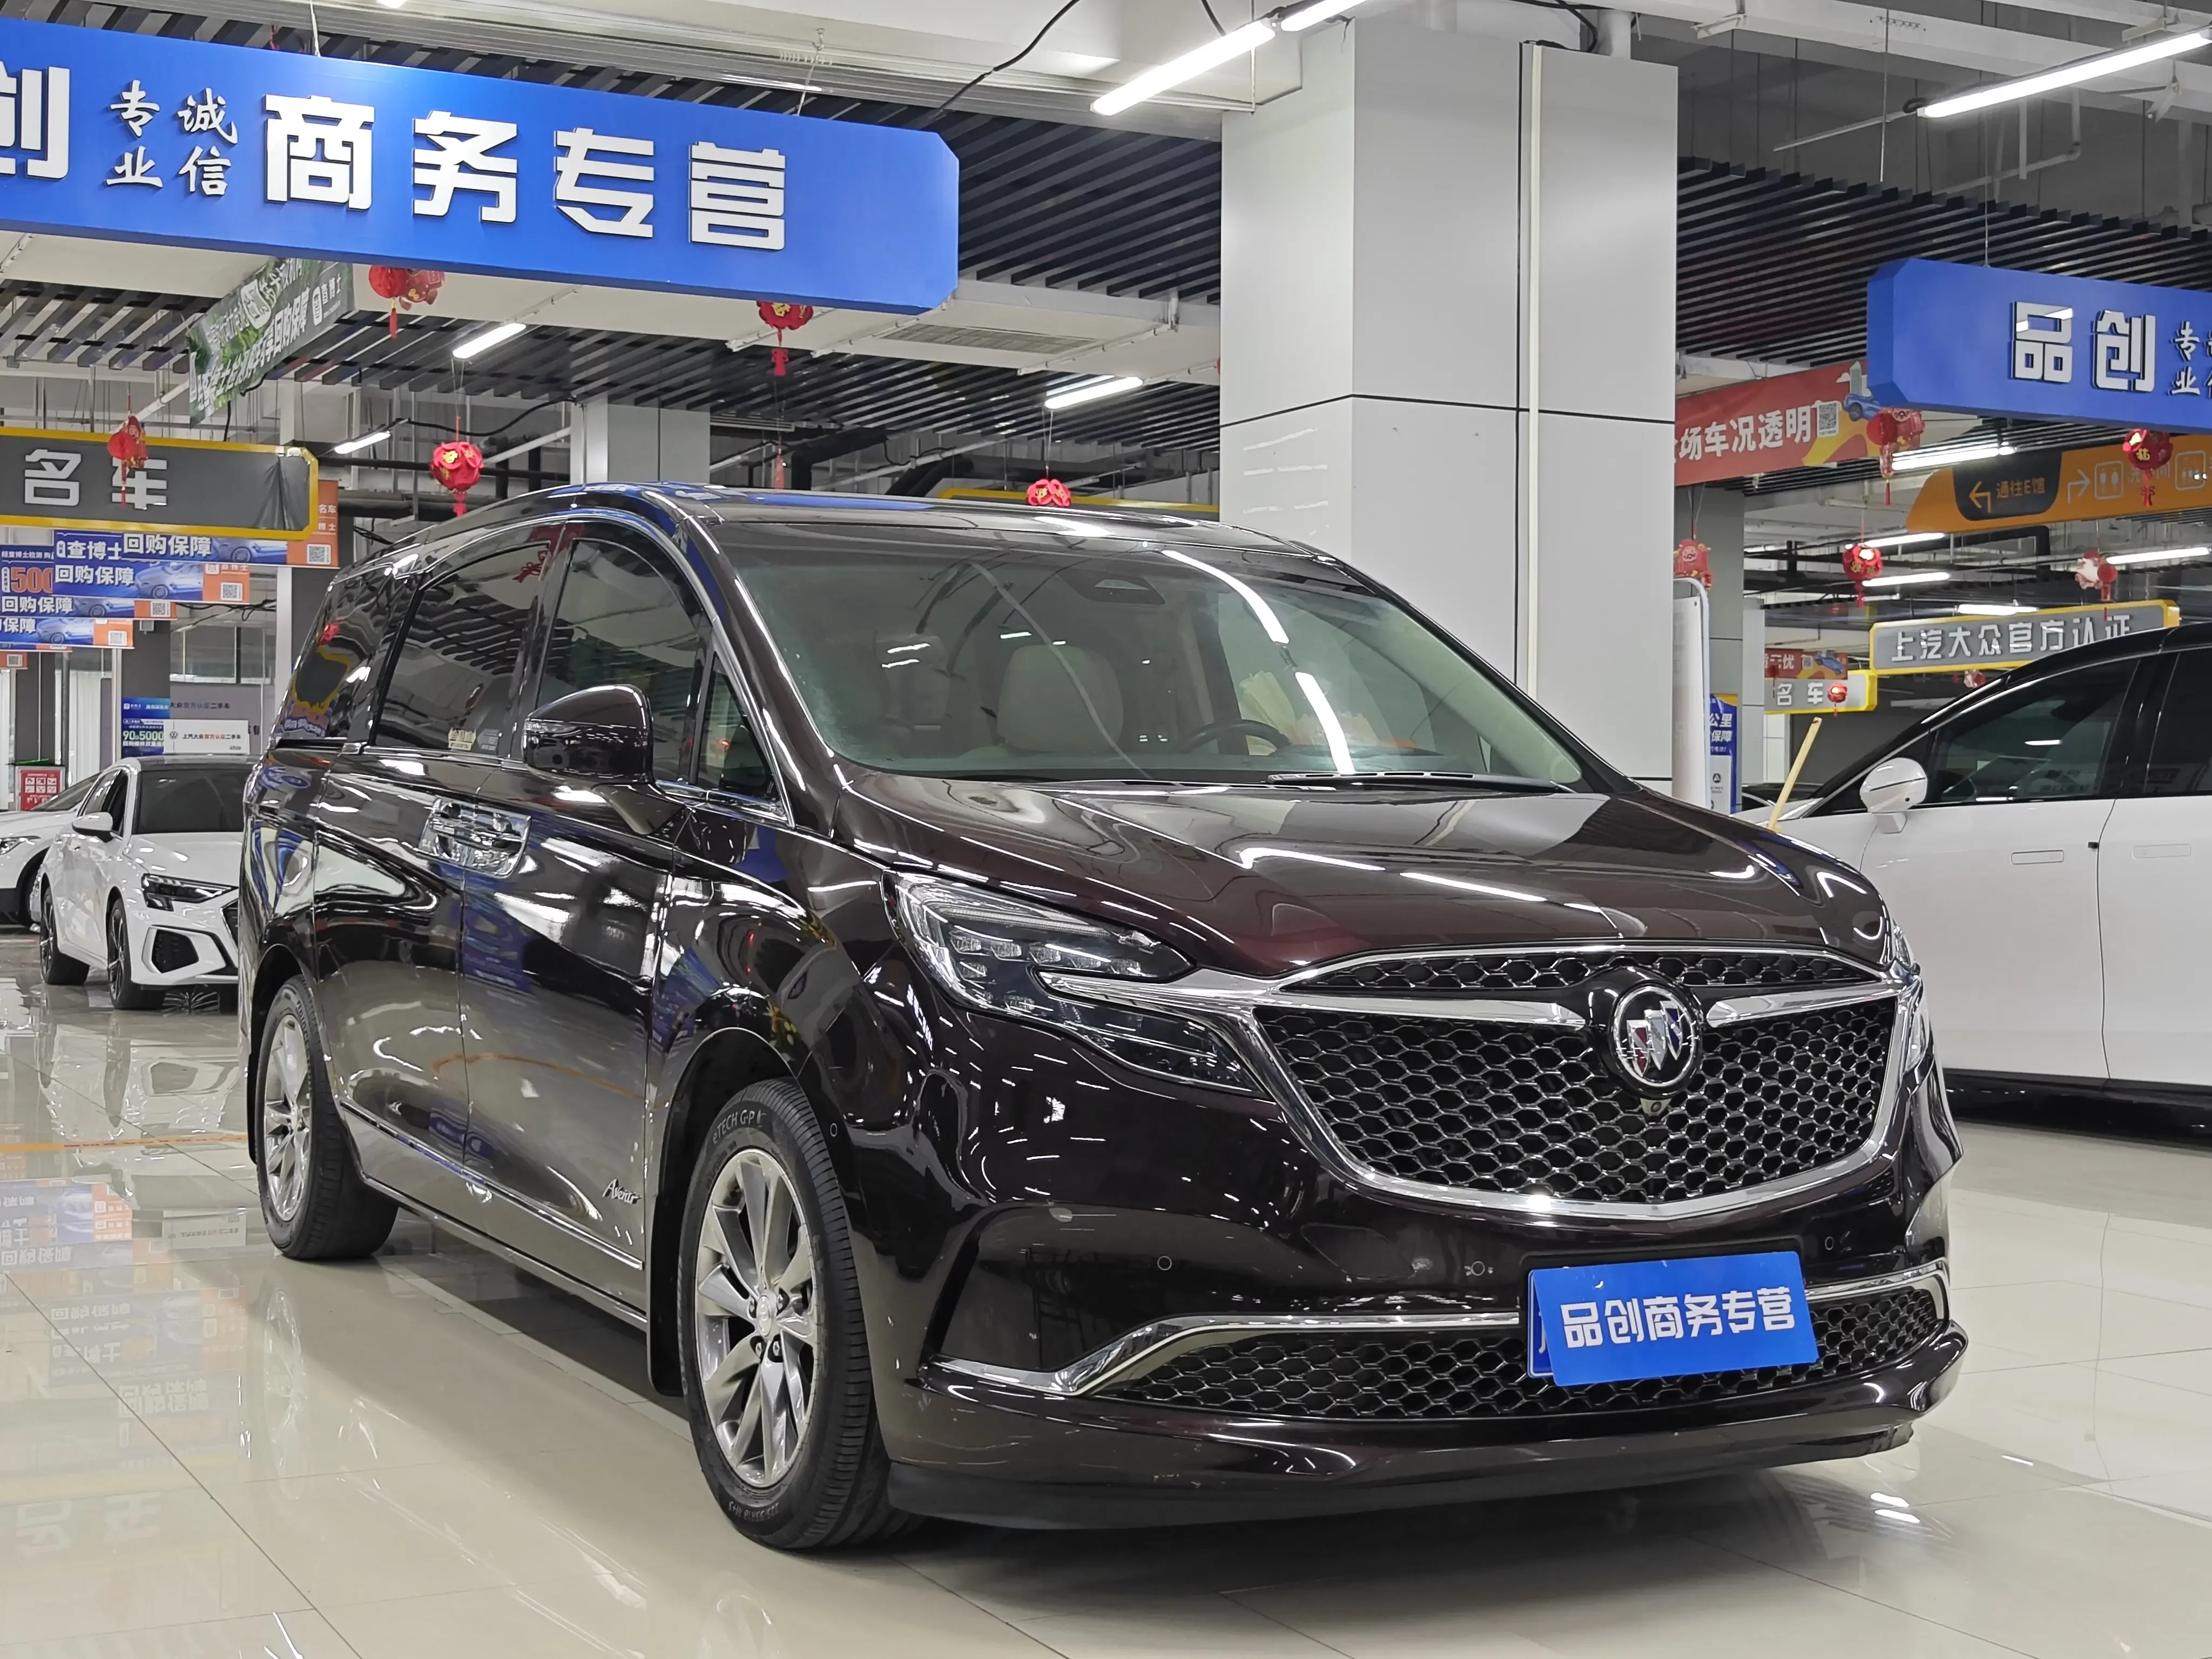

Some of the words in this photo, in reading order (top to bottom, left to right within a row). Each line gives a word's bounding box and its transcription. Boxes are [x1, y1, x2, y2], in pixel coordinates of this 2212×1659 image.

[265, 95, 786, 251] 商务专营
[2012, 301, 2156, 393] 品创
[1674, 404, 1811, 463] 场车况透明
[24, 448, 168, 510] 名车
[1996, 476, 2046, 499] 通往E馆
[67, 541, 122, 561] 查博士
[123, 533, 212, 557] 回购保障
[55, 564, 136, 586] 回购保障
[1, 596, 73, 615] 回购保障
[0, 618, 37, 634] 保障
[1891, 613, 2132, 662] 上汽大众官方认证
[1777, 682, 1824, 706] 名车
[1710, 730, 1732, 743] 保障
[1560, 1286, 1796, 1348] 品创商务专营
